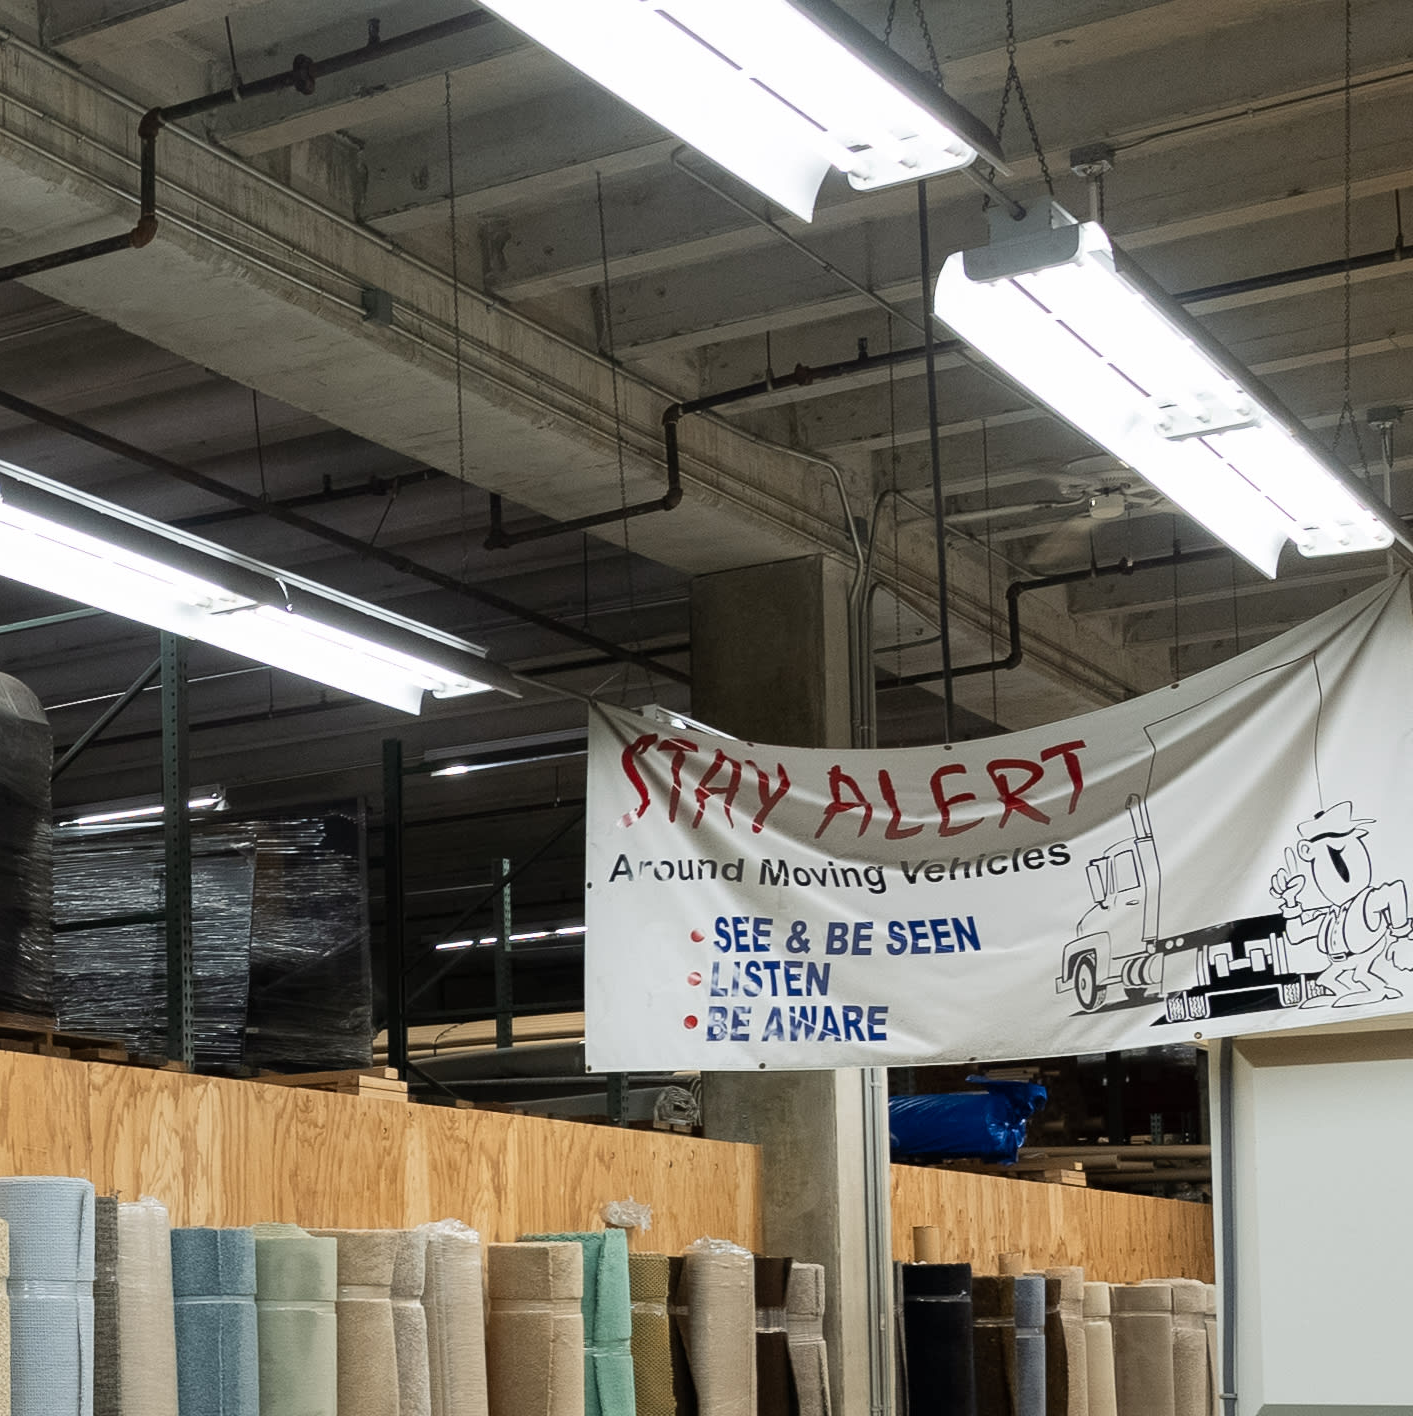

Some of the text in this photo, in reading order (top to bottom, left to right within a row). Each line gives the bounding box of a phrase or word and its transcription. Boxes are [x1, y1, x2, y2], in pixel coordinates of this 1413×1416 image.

[618, 733, 1087, 840] STAY ALERT
[609, 842, 1072, 895] Around Moving Vehicles
[714, 917, 981, 956] SEE & BE SEEN
[709, 961, 830, 998] LISTEN
[706, 1005, 888, 1043] BE AWARE
